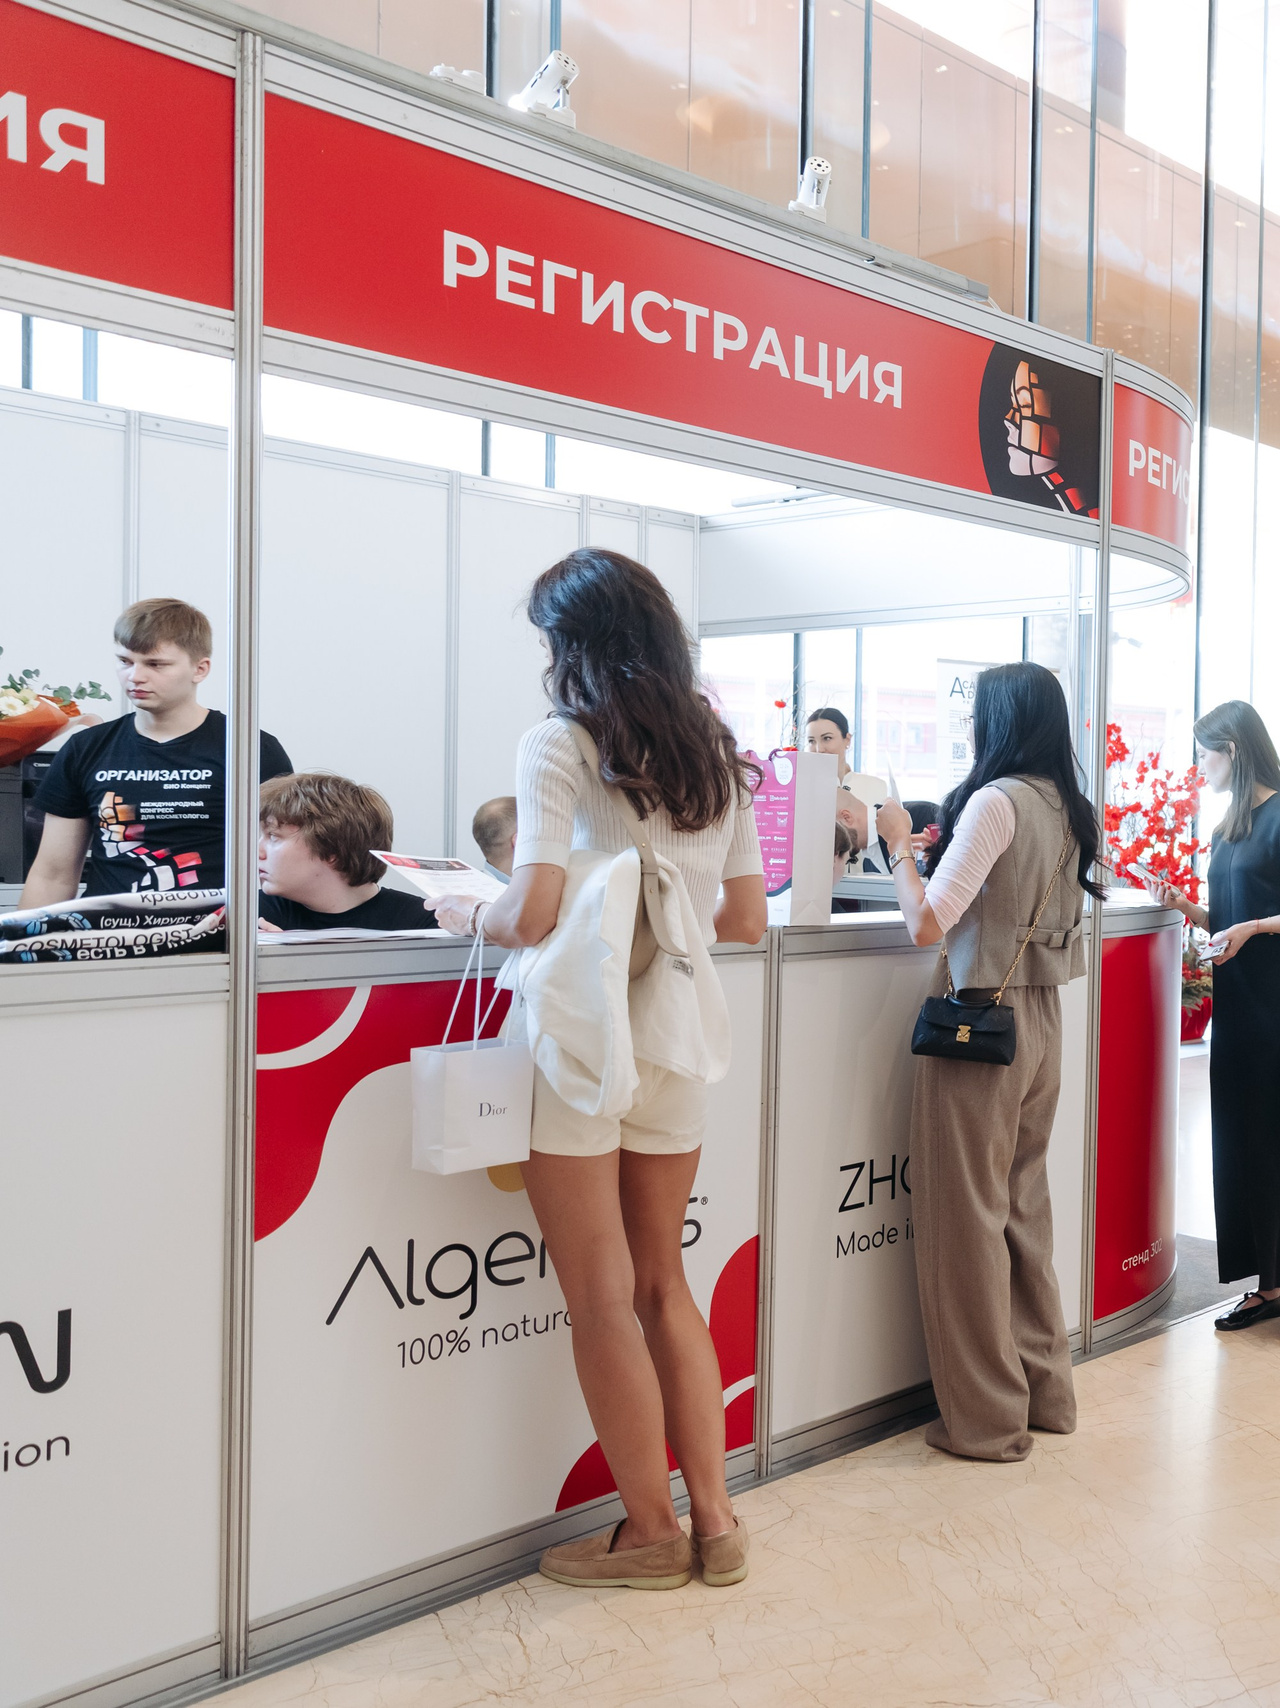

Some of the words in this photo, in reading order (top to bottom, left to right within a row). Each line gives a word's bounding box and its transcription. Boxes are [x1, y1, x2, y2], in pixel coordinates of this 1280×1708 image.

[443, 229, 903, 409] РЕГИСТРАЦИЯ
[95, 769, 213, 782] ОРГАНИЗАТОР
[100, 915, 140, 928] (сущ.)
[143, 915, 192, 926] Хирург
[77, 947, 128, 960] есть
[479, 1102, 508, 1117] Dior
[836, 1223, 899, 1258] Made
[1122, 1249, 1150, 1271] стенд
[1150, 1237, 1163, 1258] 302
[396, 1326, 471, 1368] 100%
